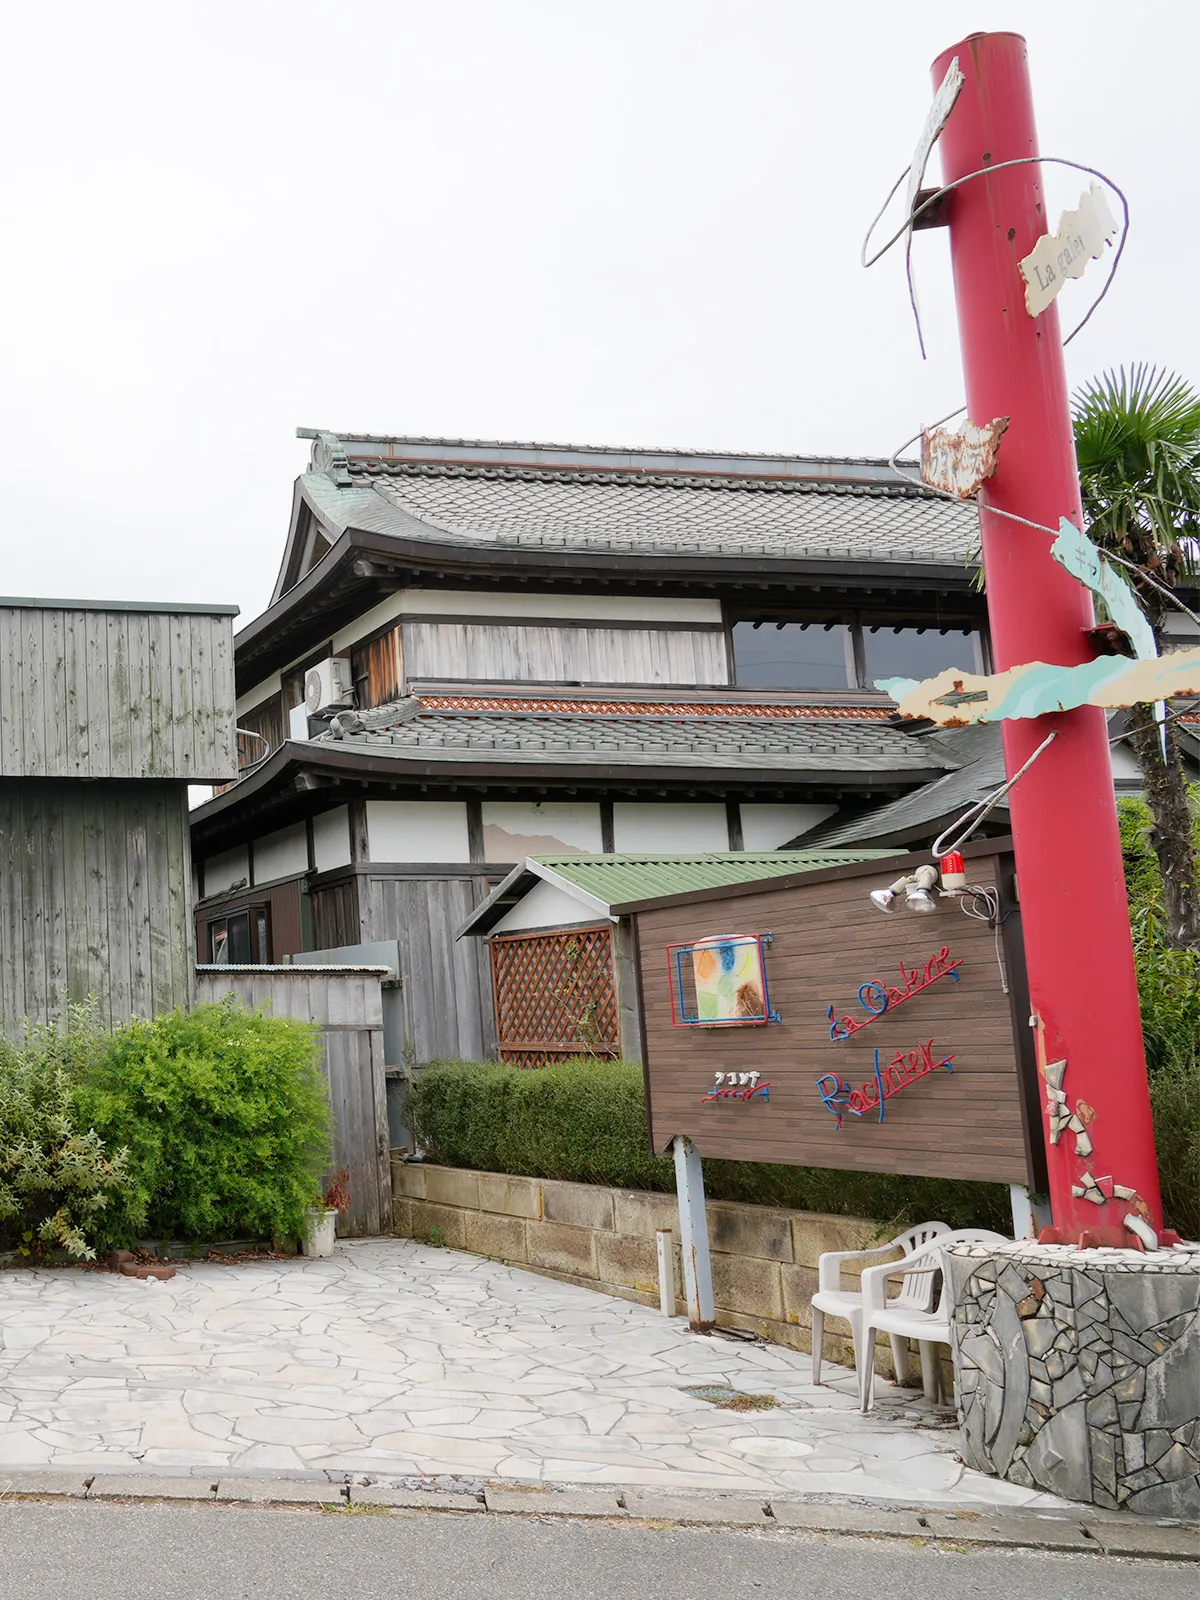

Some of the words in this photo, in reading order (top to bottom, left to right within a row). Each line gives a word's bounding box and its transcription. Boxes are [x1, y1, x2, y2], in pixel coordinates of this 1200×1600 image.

[1033, 264, 1056, 292] La
[827, 1004, 860, 1042] La
[815, 1038, 935, 1131] Raconter
